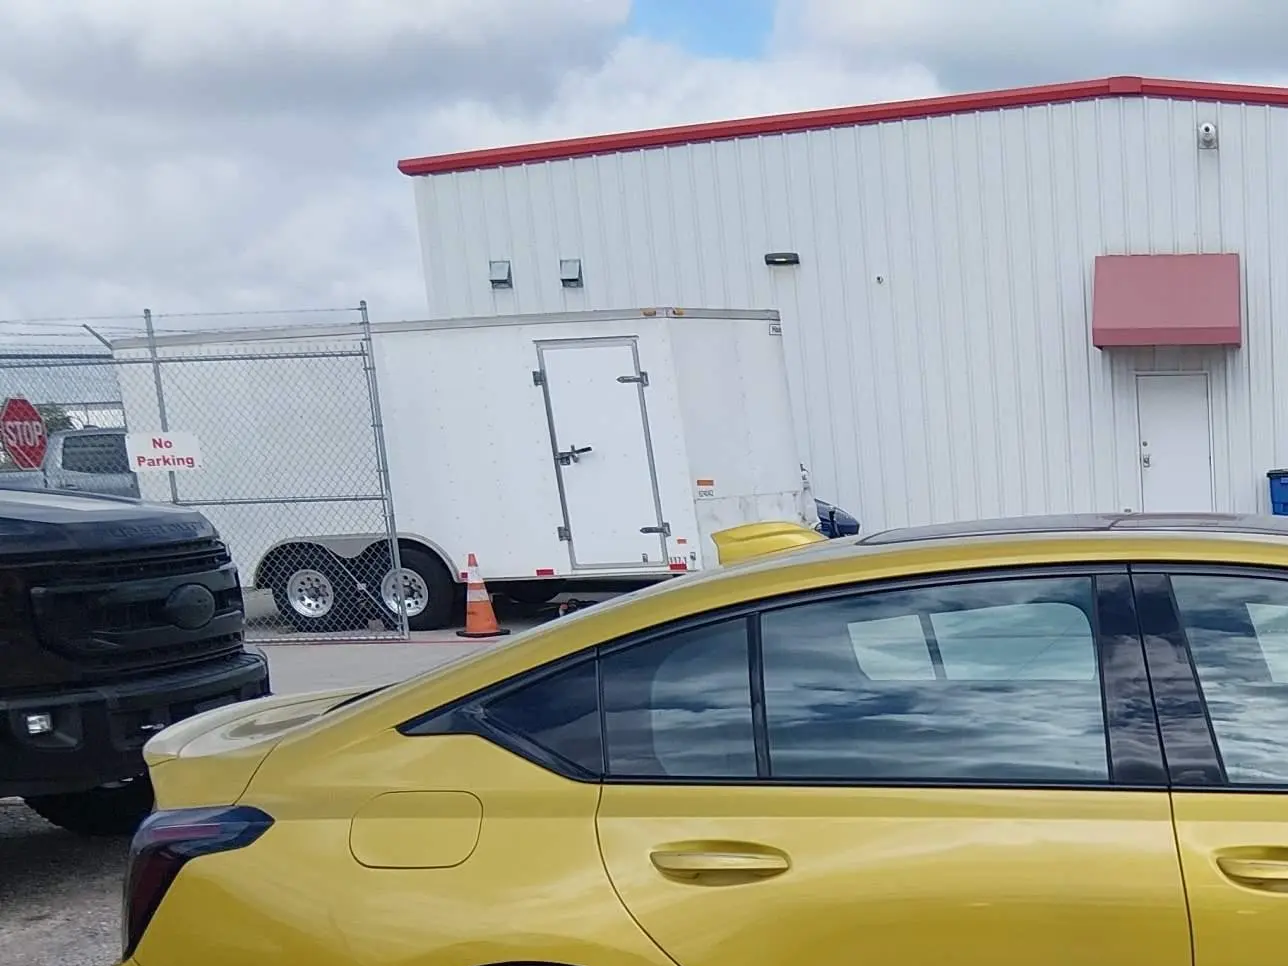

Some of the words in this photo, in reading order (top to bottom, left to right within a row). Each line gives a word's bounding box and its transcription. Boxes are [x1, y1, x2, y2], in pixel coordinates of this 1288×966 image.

[4, 421, 43, 447] STOP
[151, 438, 173, 449] No
[136, 455, 195, 468] Parking
